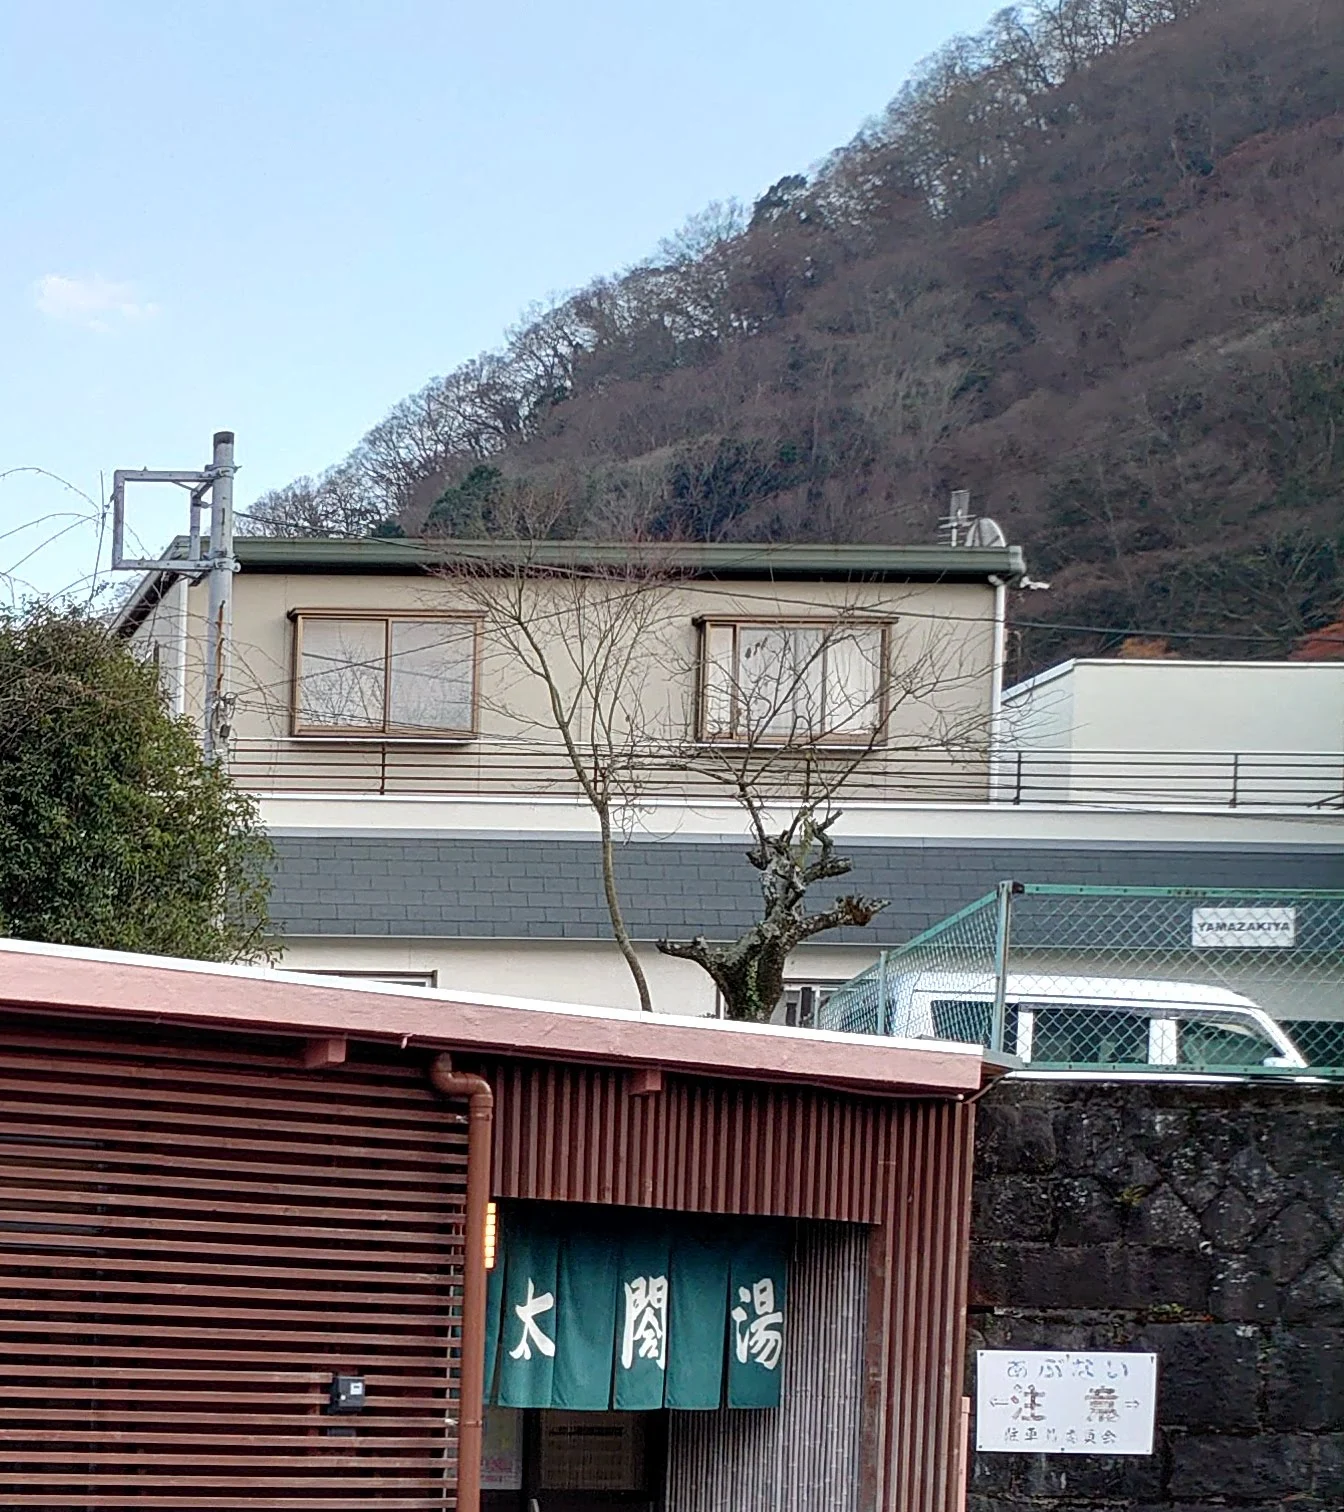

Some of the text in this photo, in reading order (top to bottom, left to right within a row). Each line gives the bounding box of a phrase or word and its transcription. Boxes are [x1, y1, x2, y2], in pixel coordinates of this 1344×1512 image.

[1197, 922, 1290, 932] YAMAZAKIYA
[509, 1275, 783, 1370] 太閤湯
